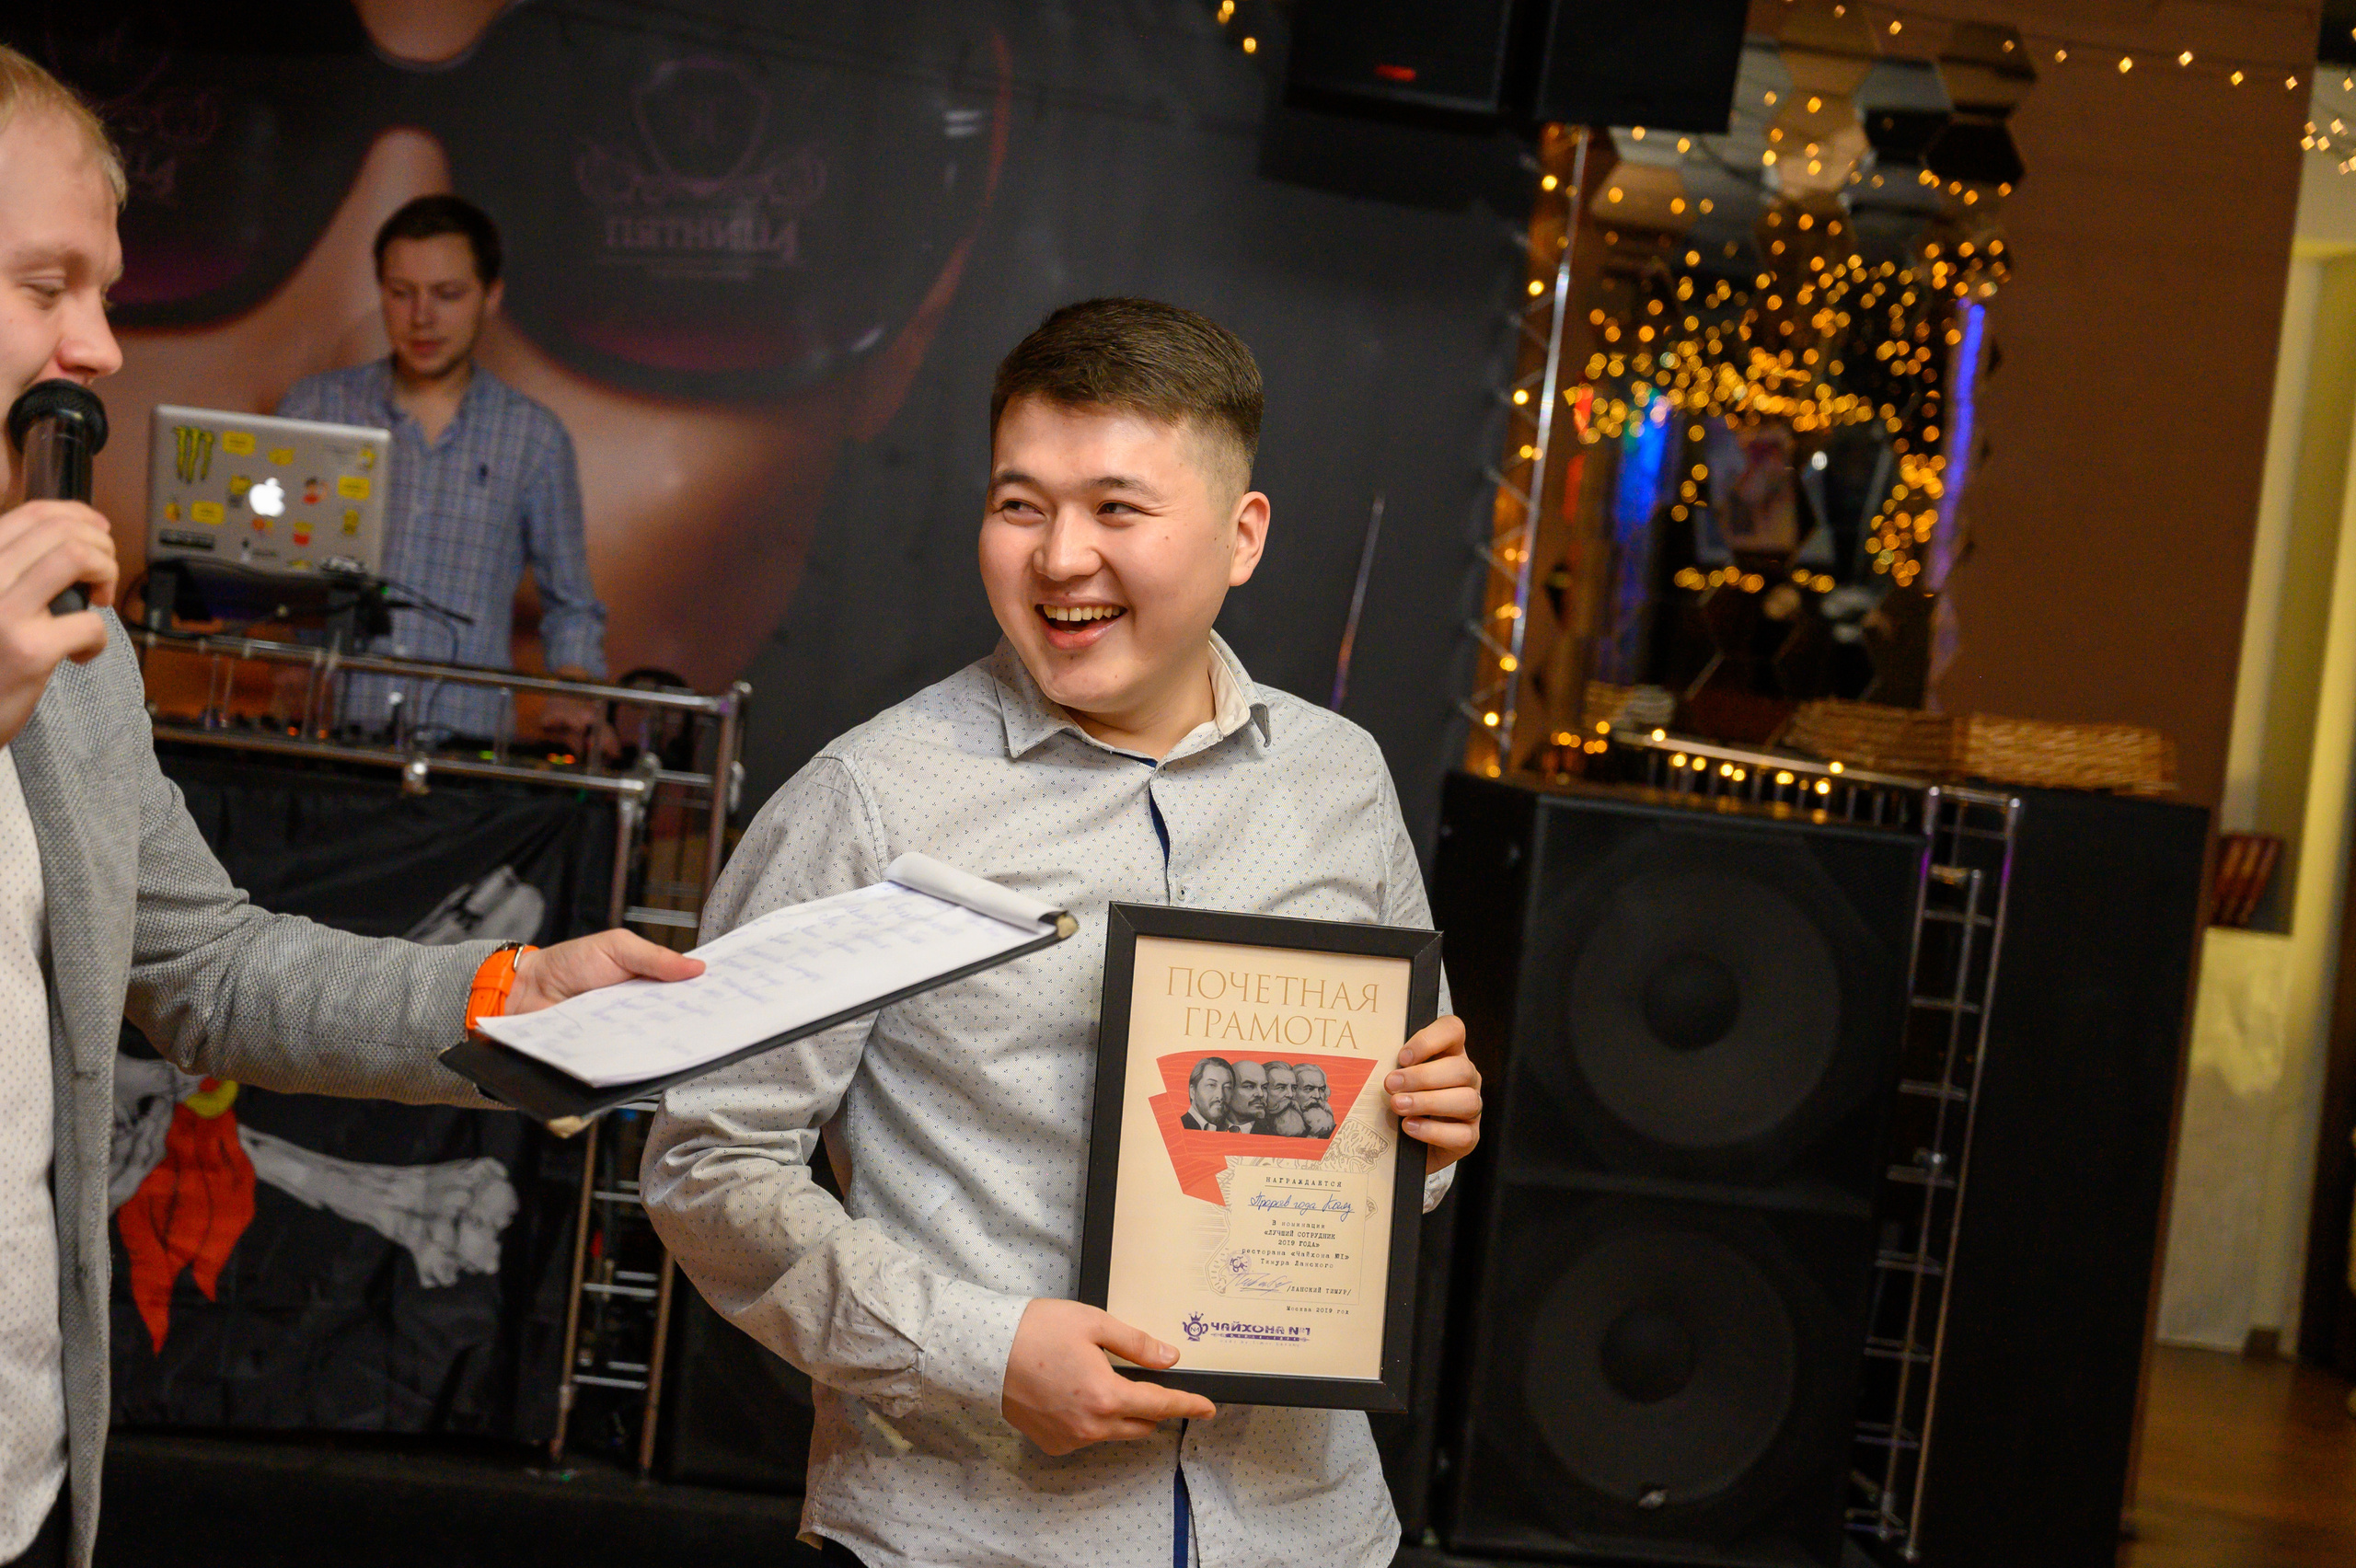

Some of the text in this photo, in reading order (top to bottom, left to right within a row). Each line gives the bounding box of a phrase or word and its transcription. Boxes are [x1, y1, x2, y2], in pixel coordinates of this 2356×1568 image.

[1166, 966, 1380, 1013] ПОЧЕТНАЯ
[1184, 1006, 1360, 1050] ГРАМОТА
[1265, 1176, 1343, 1188] НАГРАЖДАЕТСЯ
[1281, 1221, 1326, 1229] номинации
[1264, 1228, 1336, 1240] «ЛУЧШИЙ СОТРУДНИК
[1242, 1248, 1287, 1257] ресторана
[1290, 1250, 1331, 1260] «Чайхона
[1260, 1257, 1334, 1269] Тимура Ланского
[1286, 1305, 1312, 1313] Москва
[1210, 1320, 1285, 1335] ЧАЙХОНА
